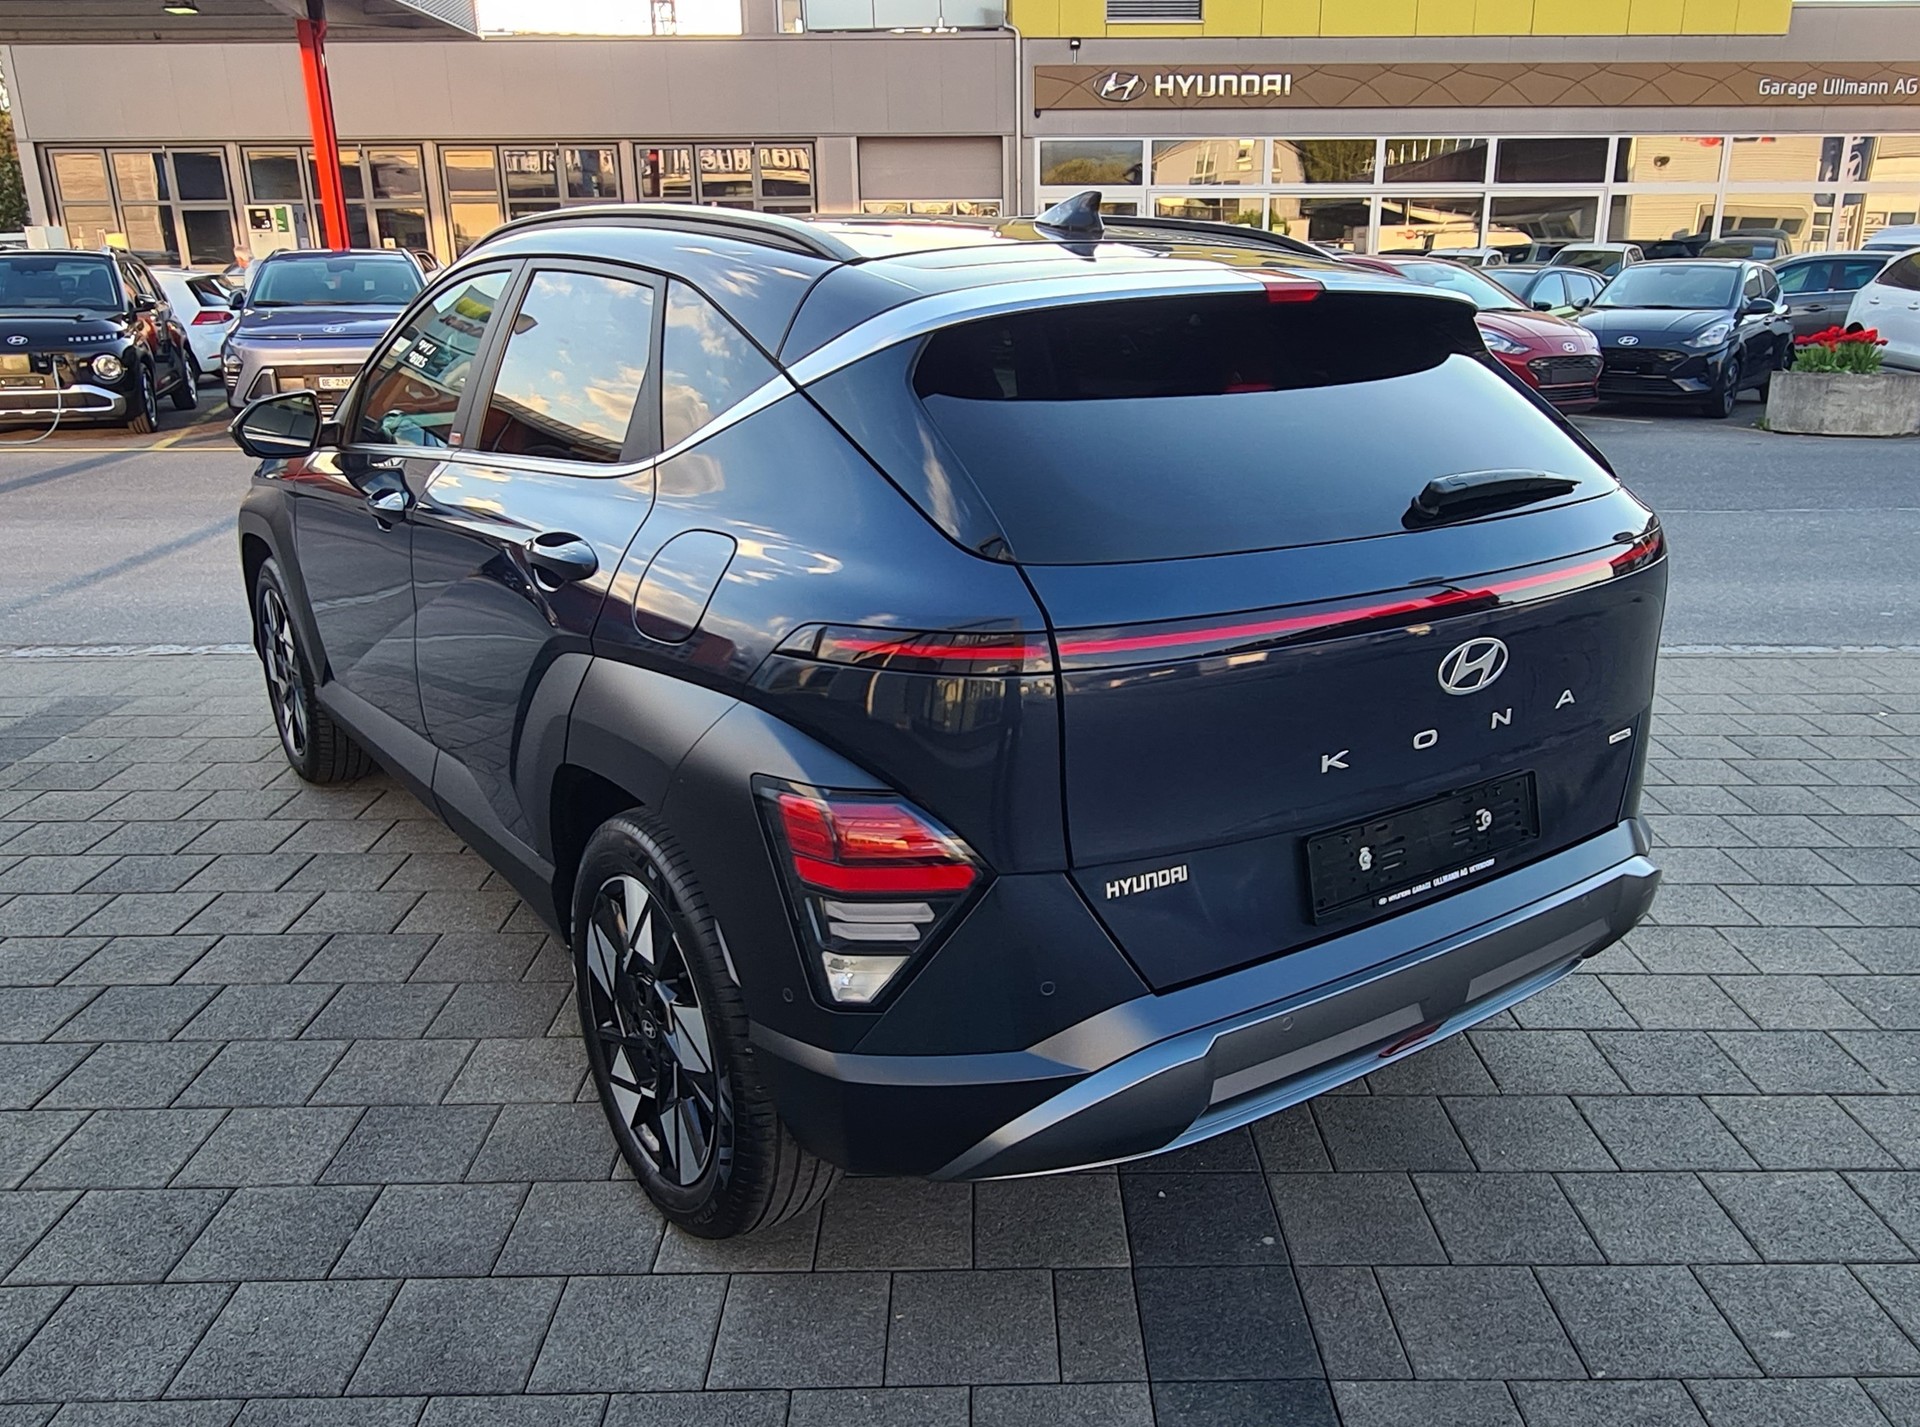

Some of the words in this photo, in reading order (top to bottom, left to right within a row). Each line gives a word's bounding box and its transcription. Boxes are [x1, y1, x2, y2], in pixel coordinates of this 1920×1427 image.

[1154, 73, 1292, 97] HYUNDAI
[1758, 78, 1818, 99] Garage
[1822, 77, 1889, 95] Ullmann
[1892, 77, 1919, 95] AG
[1321, 689, 1576, 774] KONA
[1105, 864, 1189, 900] HYUNDAI
